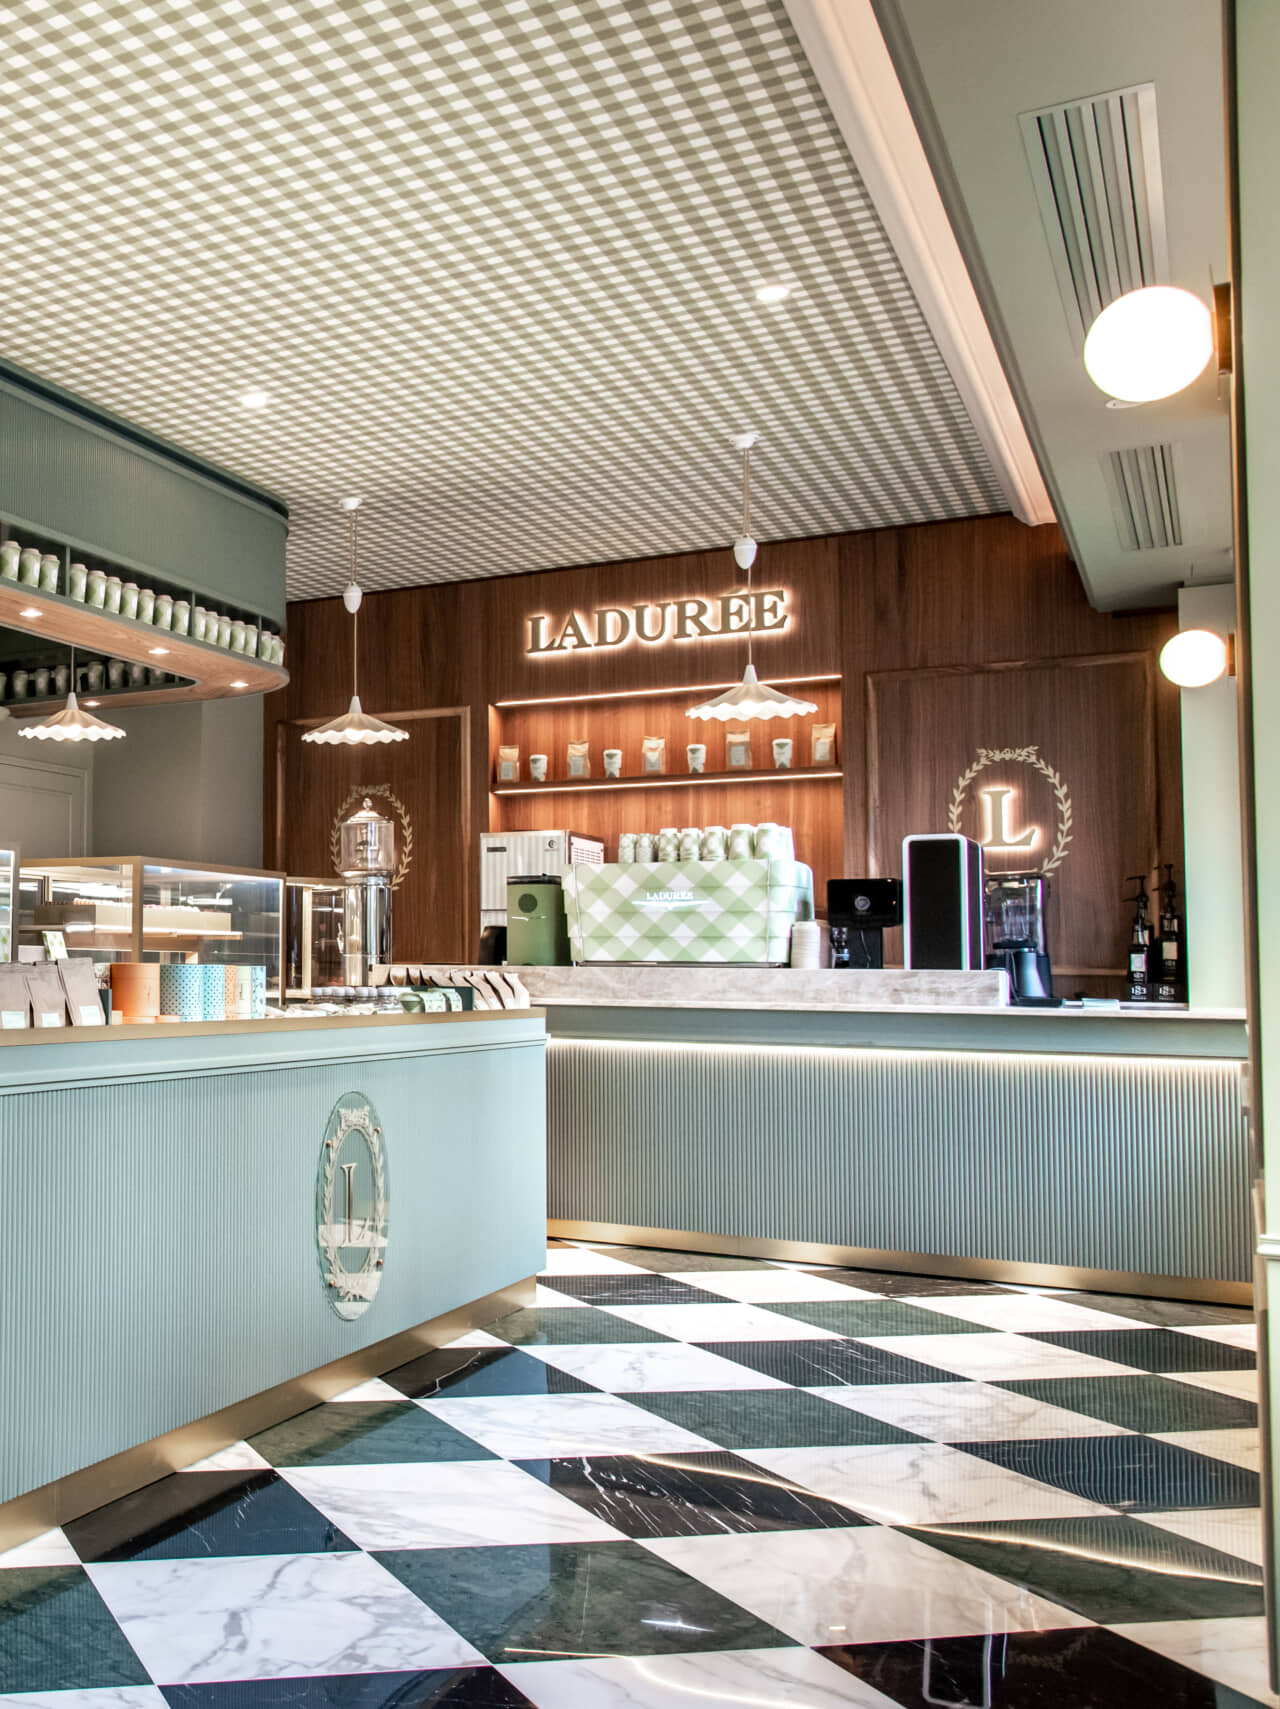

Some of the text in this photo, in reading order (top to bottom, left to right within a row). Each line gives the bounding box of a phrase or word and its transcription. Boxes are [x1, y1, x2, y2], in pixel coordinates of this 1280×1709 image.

[526, 586, 788, 653] LADURÉE
[982, 789, 1037, 847] L
[340, 1162, 371, 1248] L
